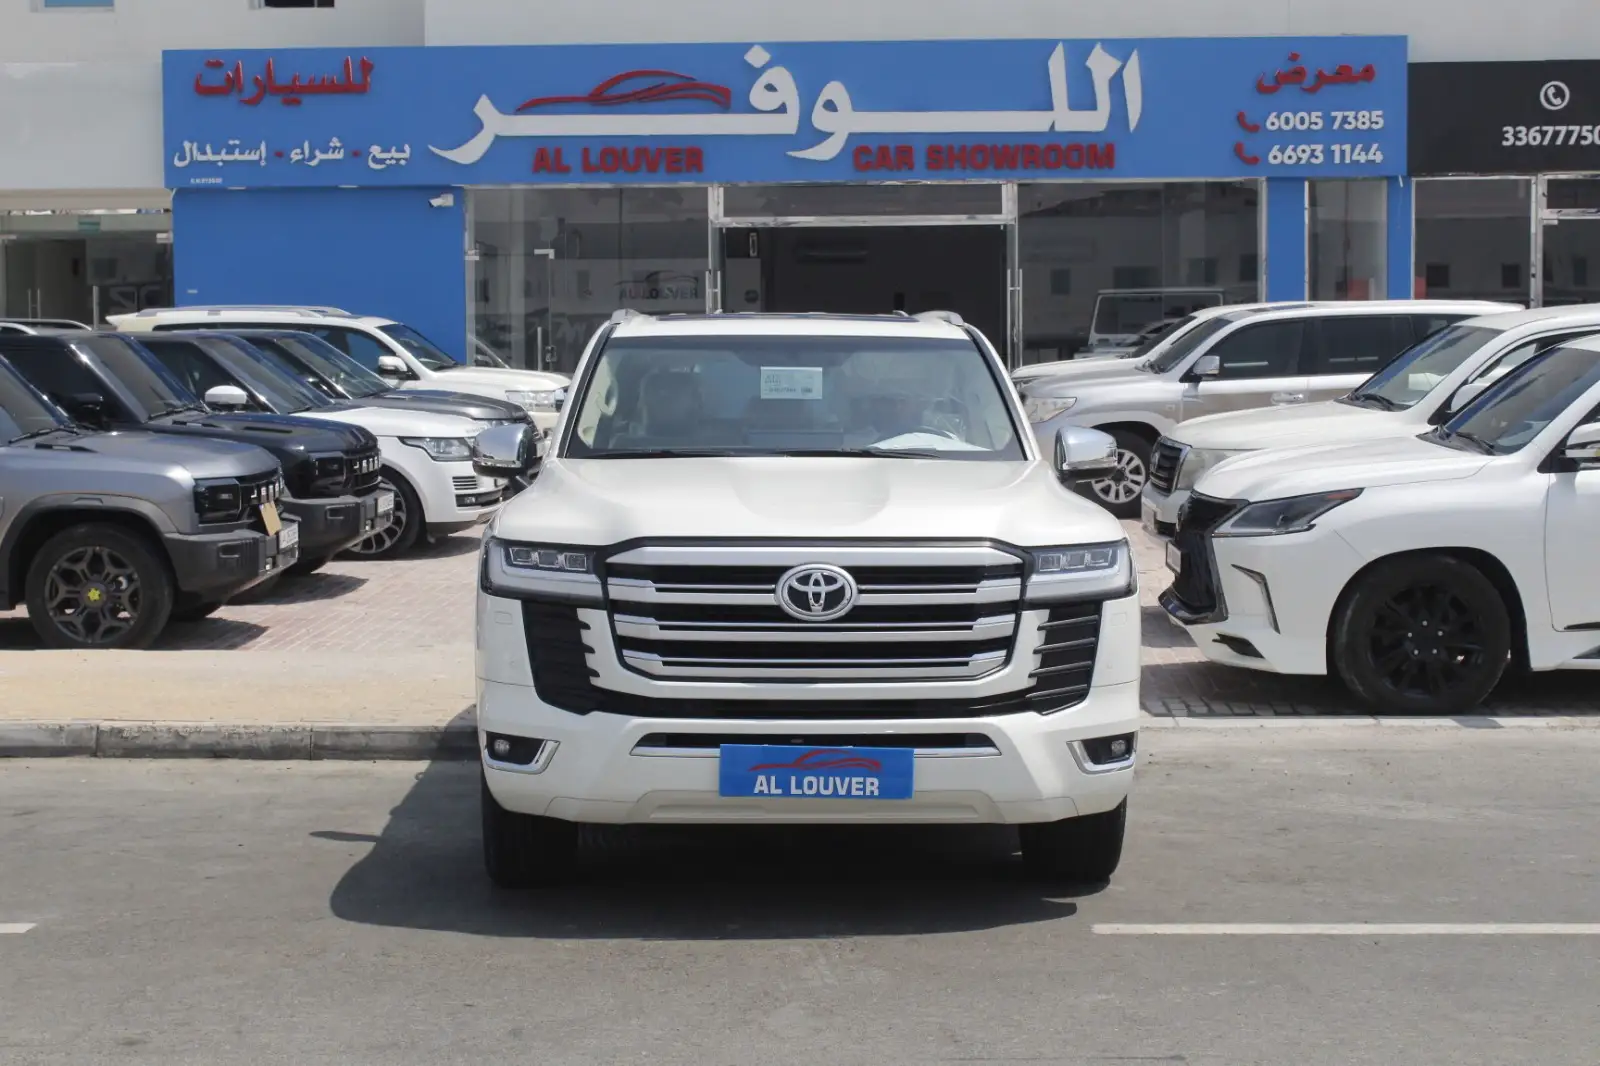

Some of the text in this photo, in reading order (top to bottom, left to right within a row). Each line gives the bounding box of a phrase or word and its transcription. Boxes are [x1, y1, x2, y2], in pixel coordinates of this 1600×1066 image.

[194, 55, 374, 106] للسيارات
[1256, 52, 1377, 93] معرض
[428, 41, 1142, 165] اللوفر
[1265, 110, 1384, 131] 6005 7385
[173, 136, 412, 170] بيع شراء إستبدال
[532, 145, 704, 174] AL LOUVER
[853, 143, 1116, 172] CAR SHOWROOM
[1267, 144, 1384, 165] 6693 1144
[753, 775, 880, 796] AL LOUVER
